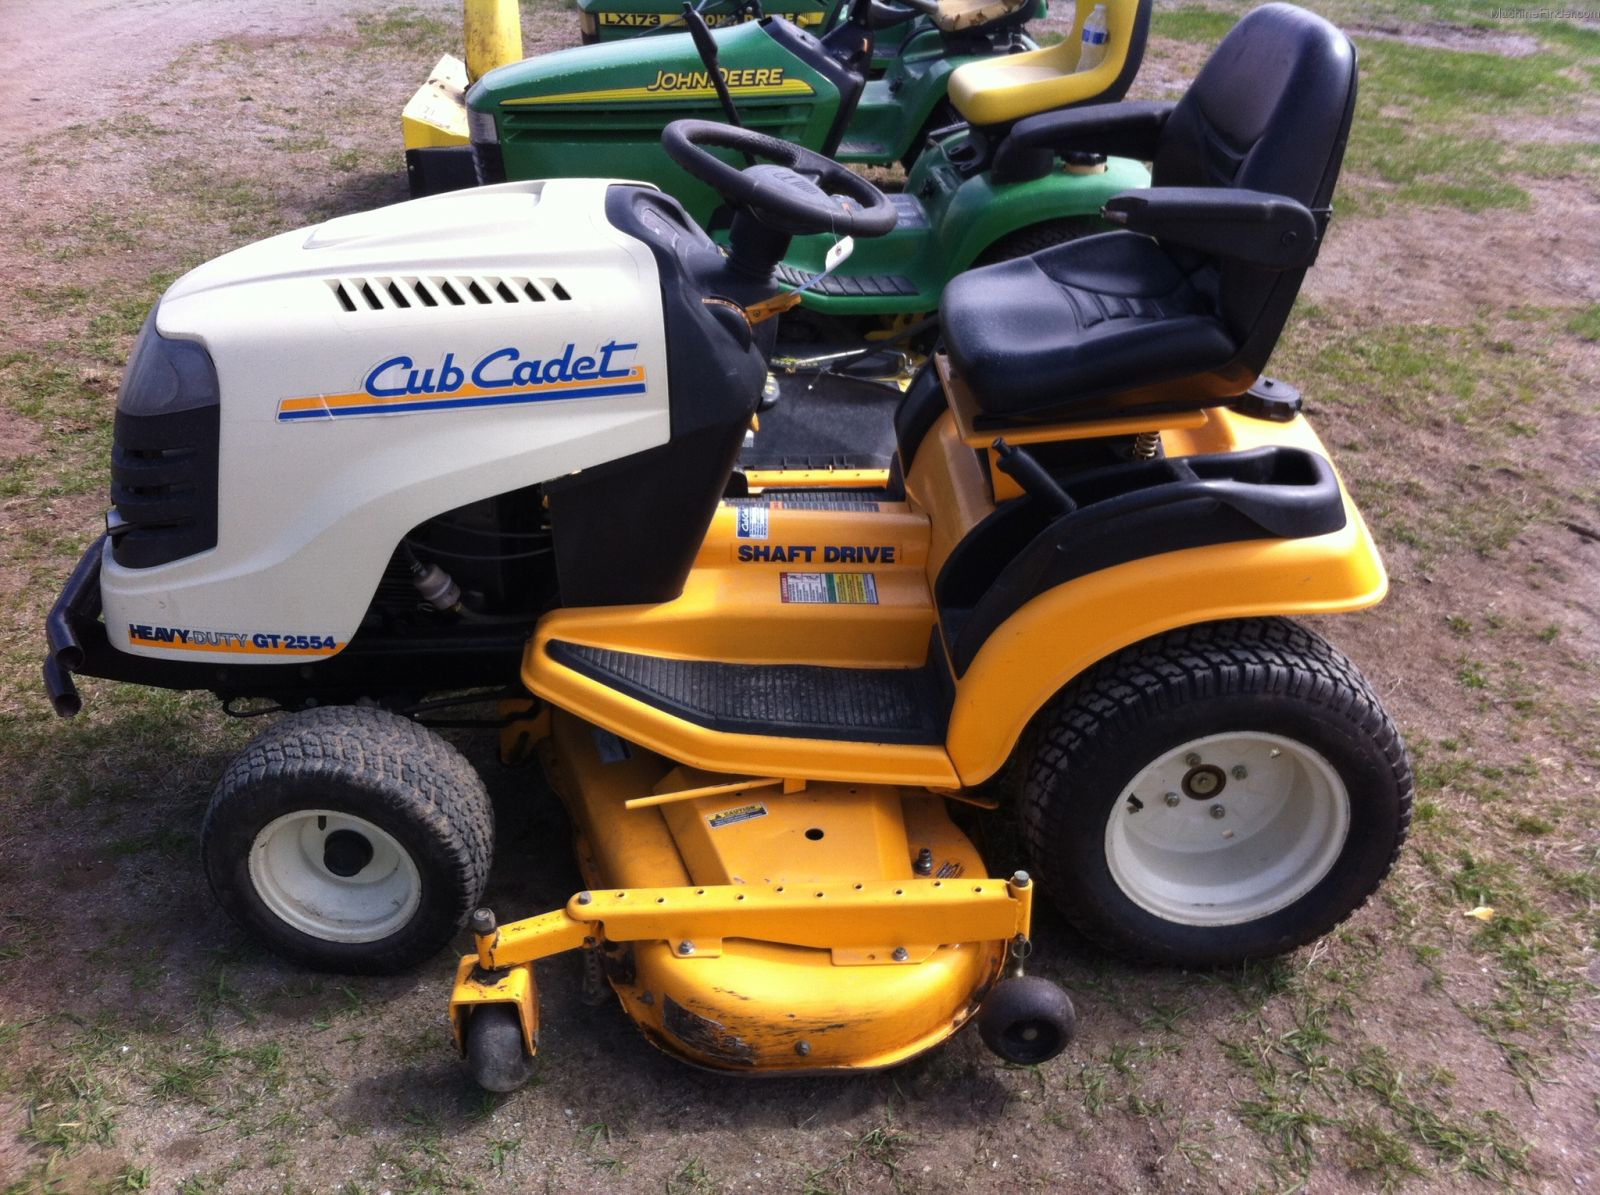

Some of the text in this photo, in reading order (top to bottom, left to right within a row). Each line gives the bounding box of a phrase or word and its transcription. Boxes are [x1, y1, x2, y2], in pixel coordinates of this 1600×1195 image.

[605, 12, 661, 25] LX173
[647, 69, 709, 91] JOHN
[365, 340, 638, 397] Cub Cadet
[738, 545, 896, 564] SHAFT DRIVE
[128, 623, 248, 648] HEAVY-DUTY
